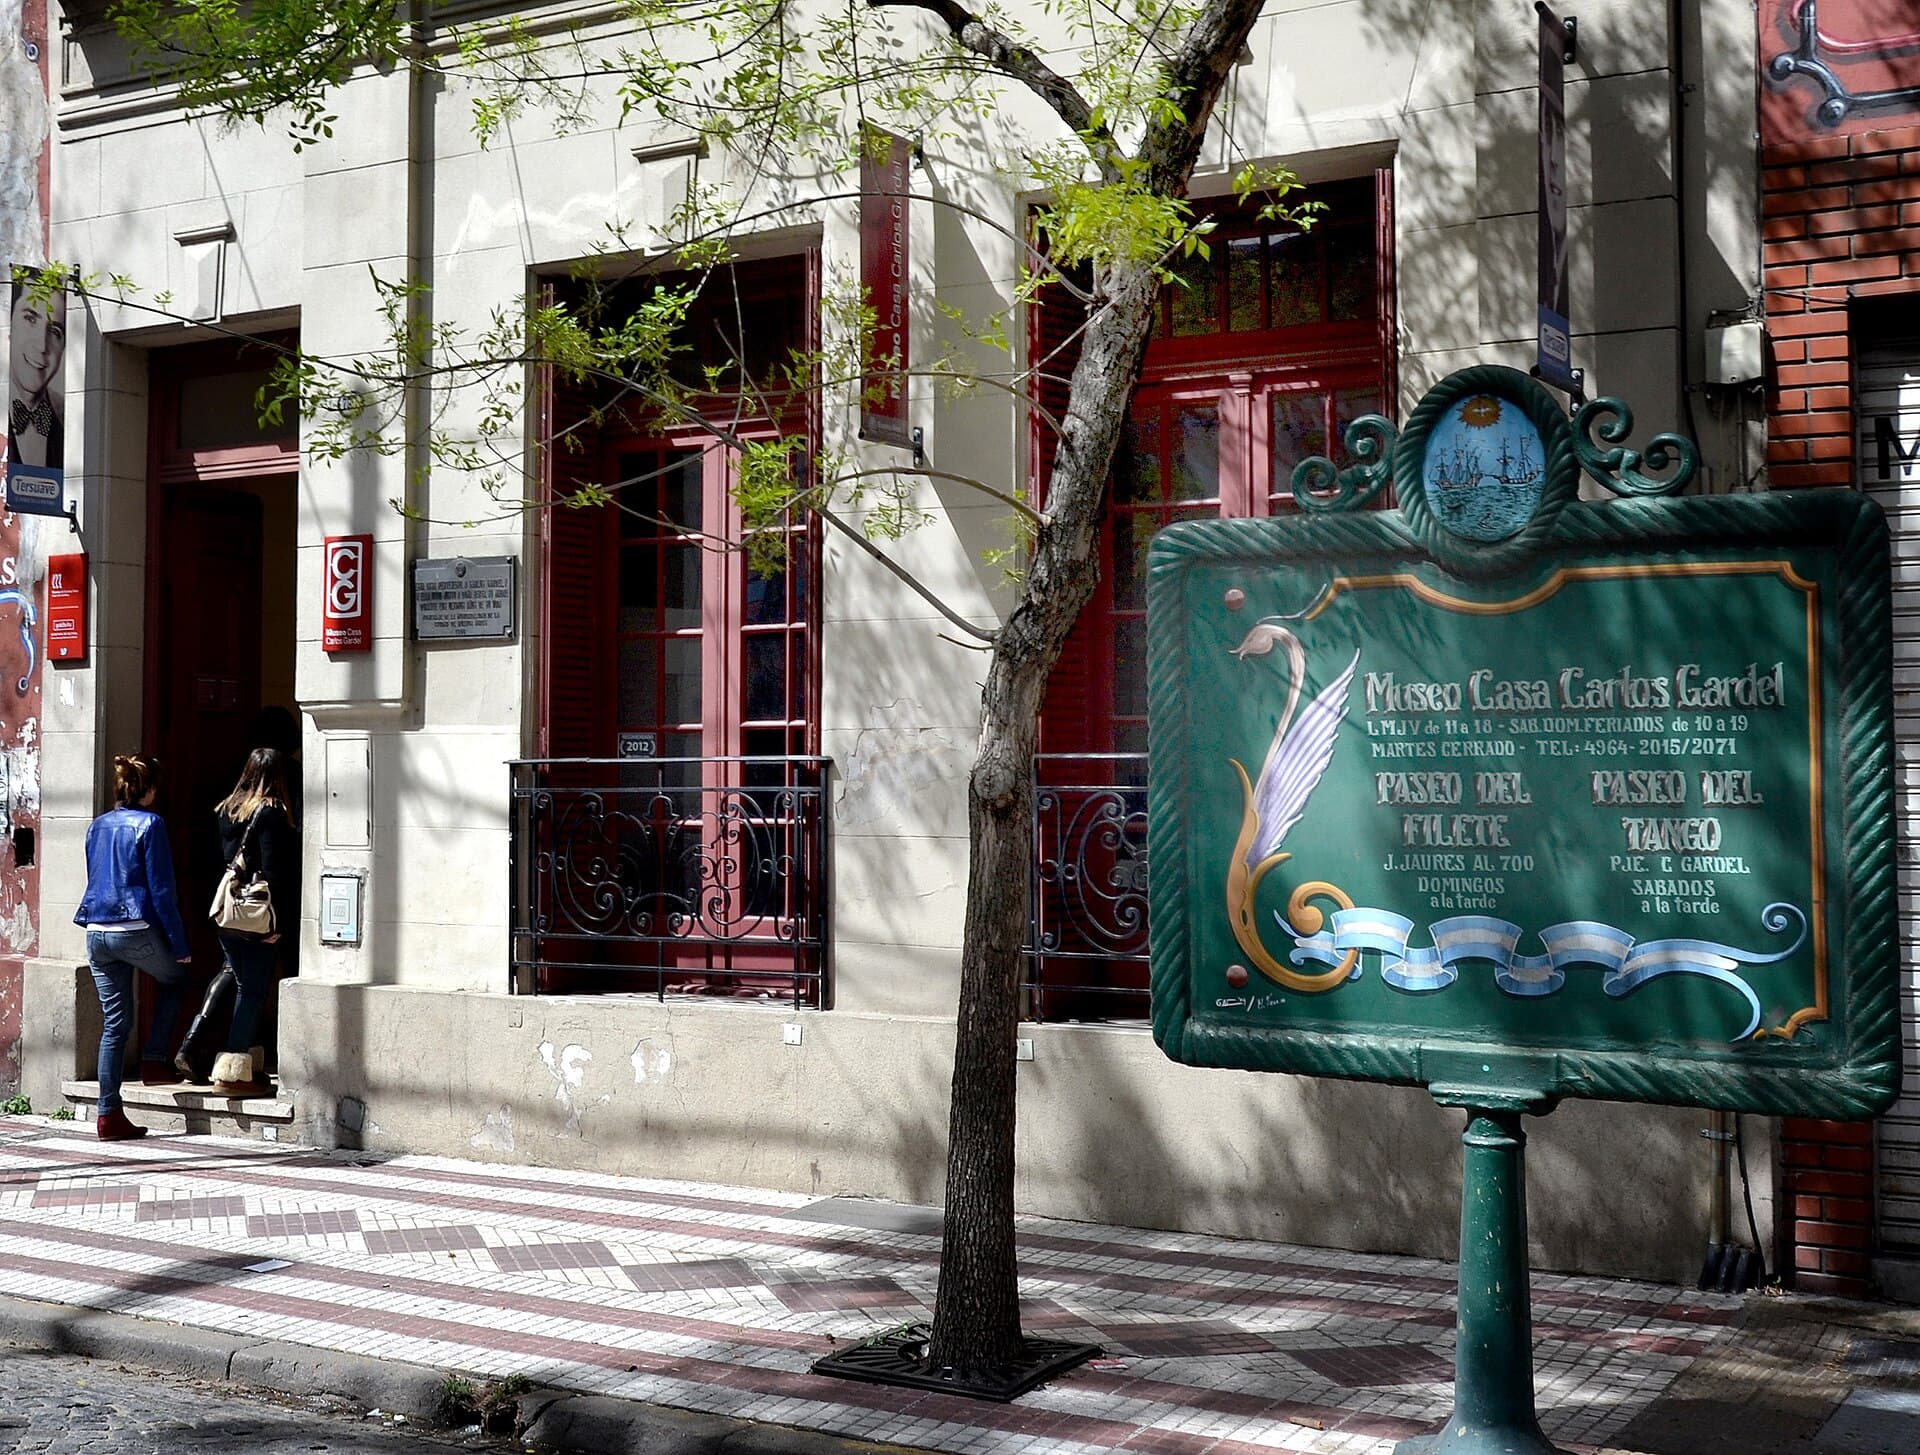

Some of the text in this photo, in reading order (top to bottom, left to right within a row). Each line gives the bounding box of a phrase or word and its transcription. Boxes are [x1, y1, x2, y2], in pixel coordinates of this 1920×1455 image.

[891, 223, 901, 279] Carlos
[891, 282, 901, 328] Casa
[15, 478, 56, 495] Tersuave
[1365, 662, 1787, 715] Museo Casa Carlos Gardel
[1424, 719, 1441, 735] de
[1474, 719, 1493, 734] 18
[1671, 716, 1689, 732] de
[1695, 715, 1713, 732] 10
[1716, 719, 1726, 732] a
[1729, 715, 1749, 732] 19
[626, 741, 649, 752] 2012
[1371, 741, 1437, 758] MARTES
[1441, 740, 1515, 757] CERRADO
[1536, 740, 1580, 756] TEL:
[1376, 771, 1533, 805] PASEO DEL
[1592, 770, 1765, 806] PASEO DEL
[1402, 813, 1511, 847] FILETE
[1621, 816, 1722, 853] TANGO
[1473, 854, 1496, 872] AL
[1499, 855, 1535, 872] 700
[1610, 855, 1649, 873] PJE.
[1680, 855, 1751, 874] GARDEL
[1418, 876, 1505, 894] DOMINGOS
[1631, 879, 1716, 897] SABADOS
[1456, 893, 1497, 909] tarde
[1641, 896, 1720, 914] a la tarde
